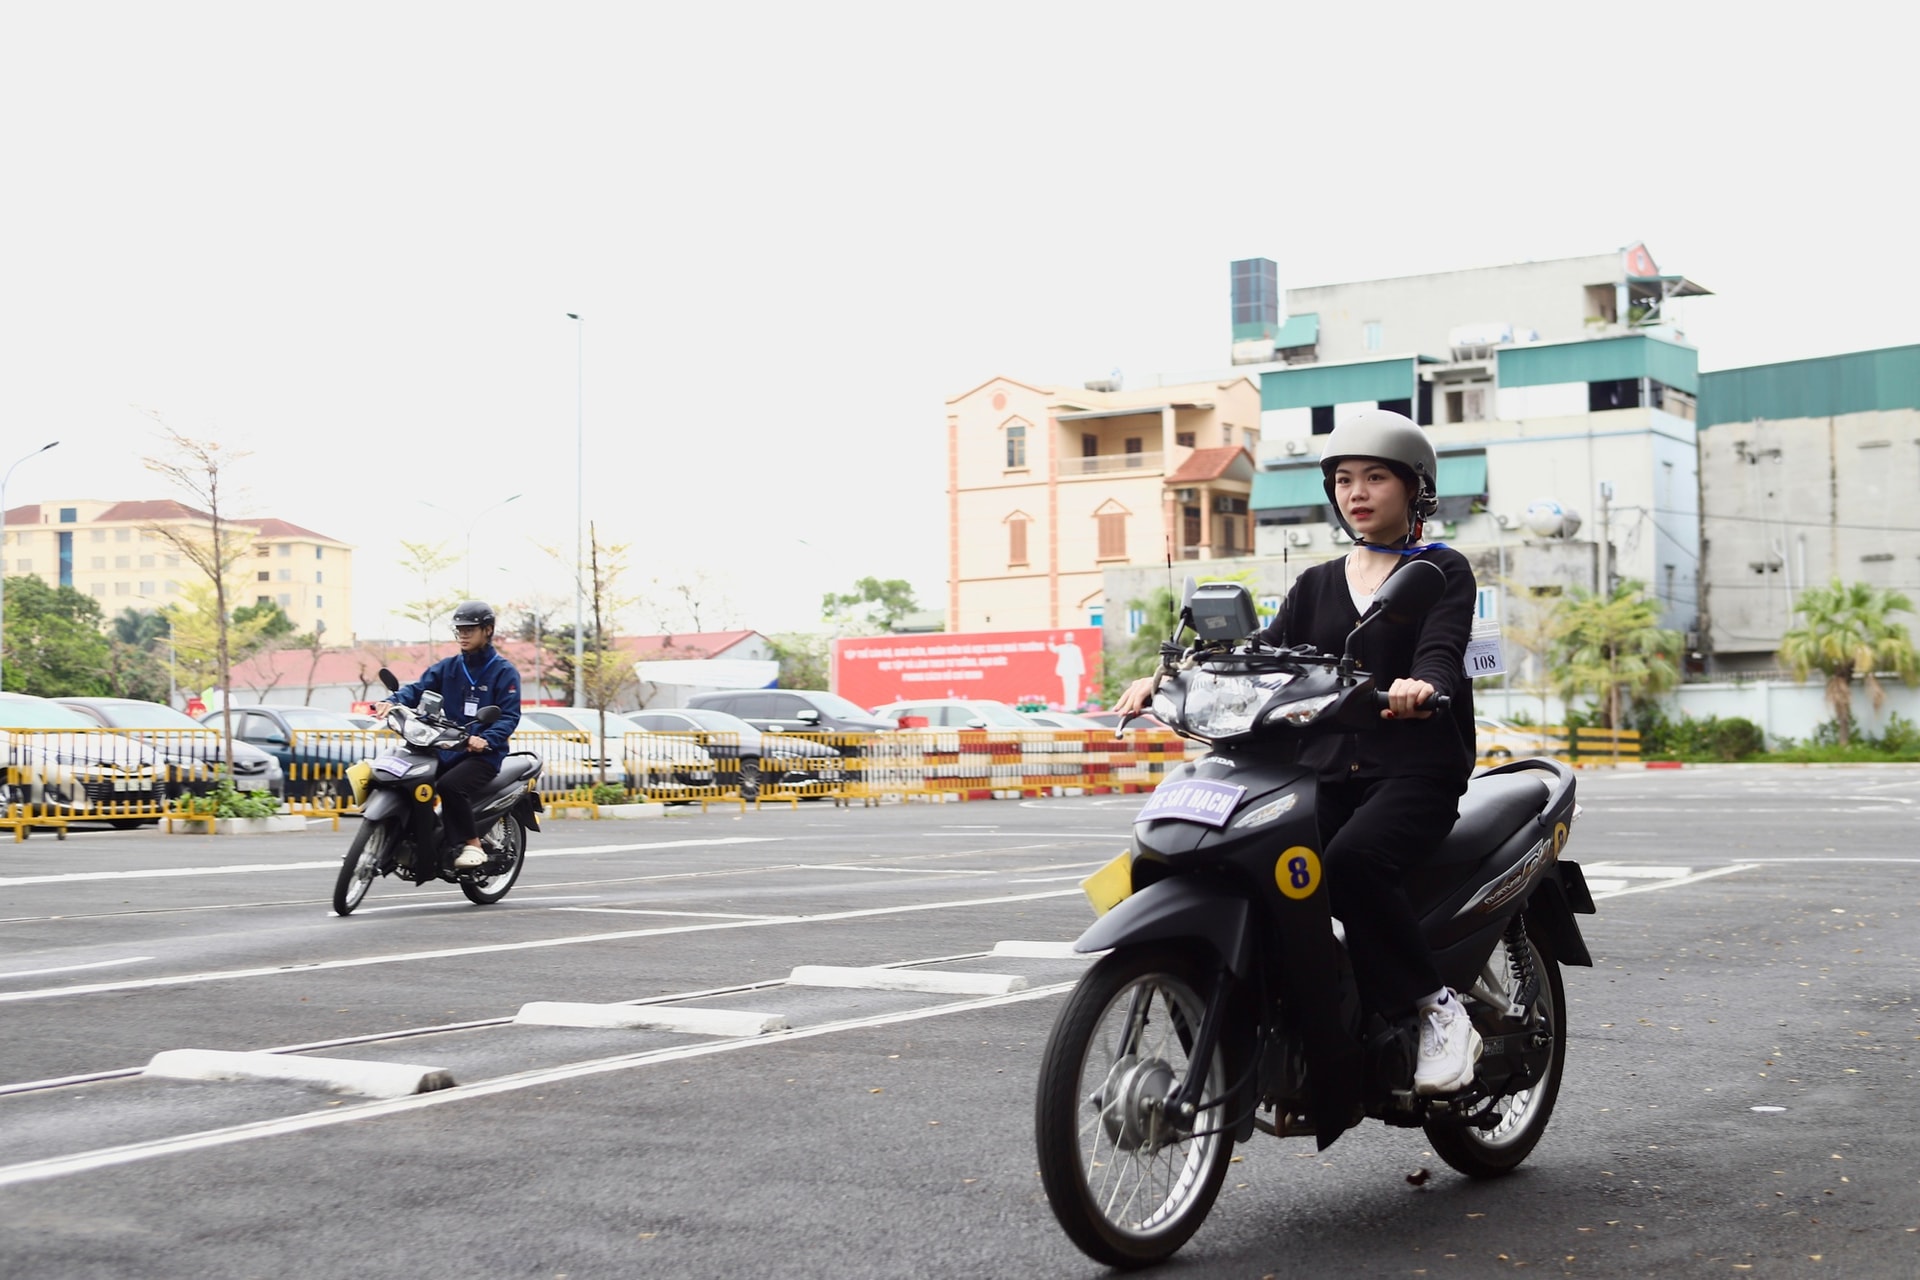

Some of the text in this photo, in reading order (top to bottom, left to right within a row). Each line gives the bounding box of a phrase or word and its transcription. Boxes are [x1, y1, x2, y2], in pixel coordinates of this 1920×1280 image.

[1473, 654, 1496, 671] 108
[420, 786, 429, 798] 4
[1162, 784, 1194, 808] SÁT
[1186, 788, 1233, 814] HẠCH
[1288, 856, 1310, 889] 8
